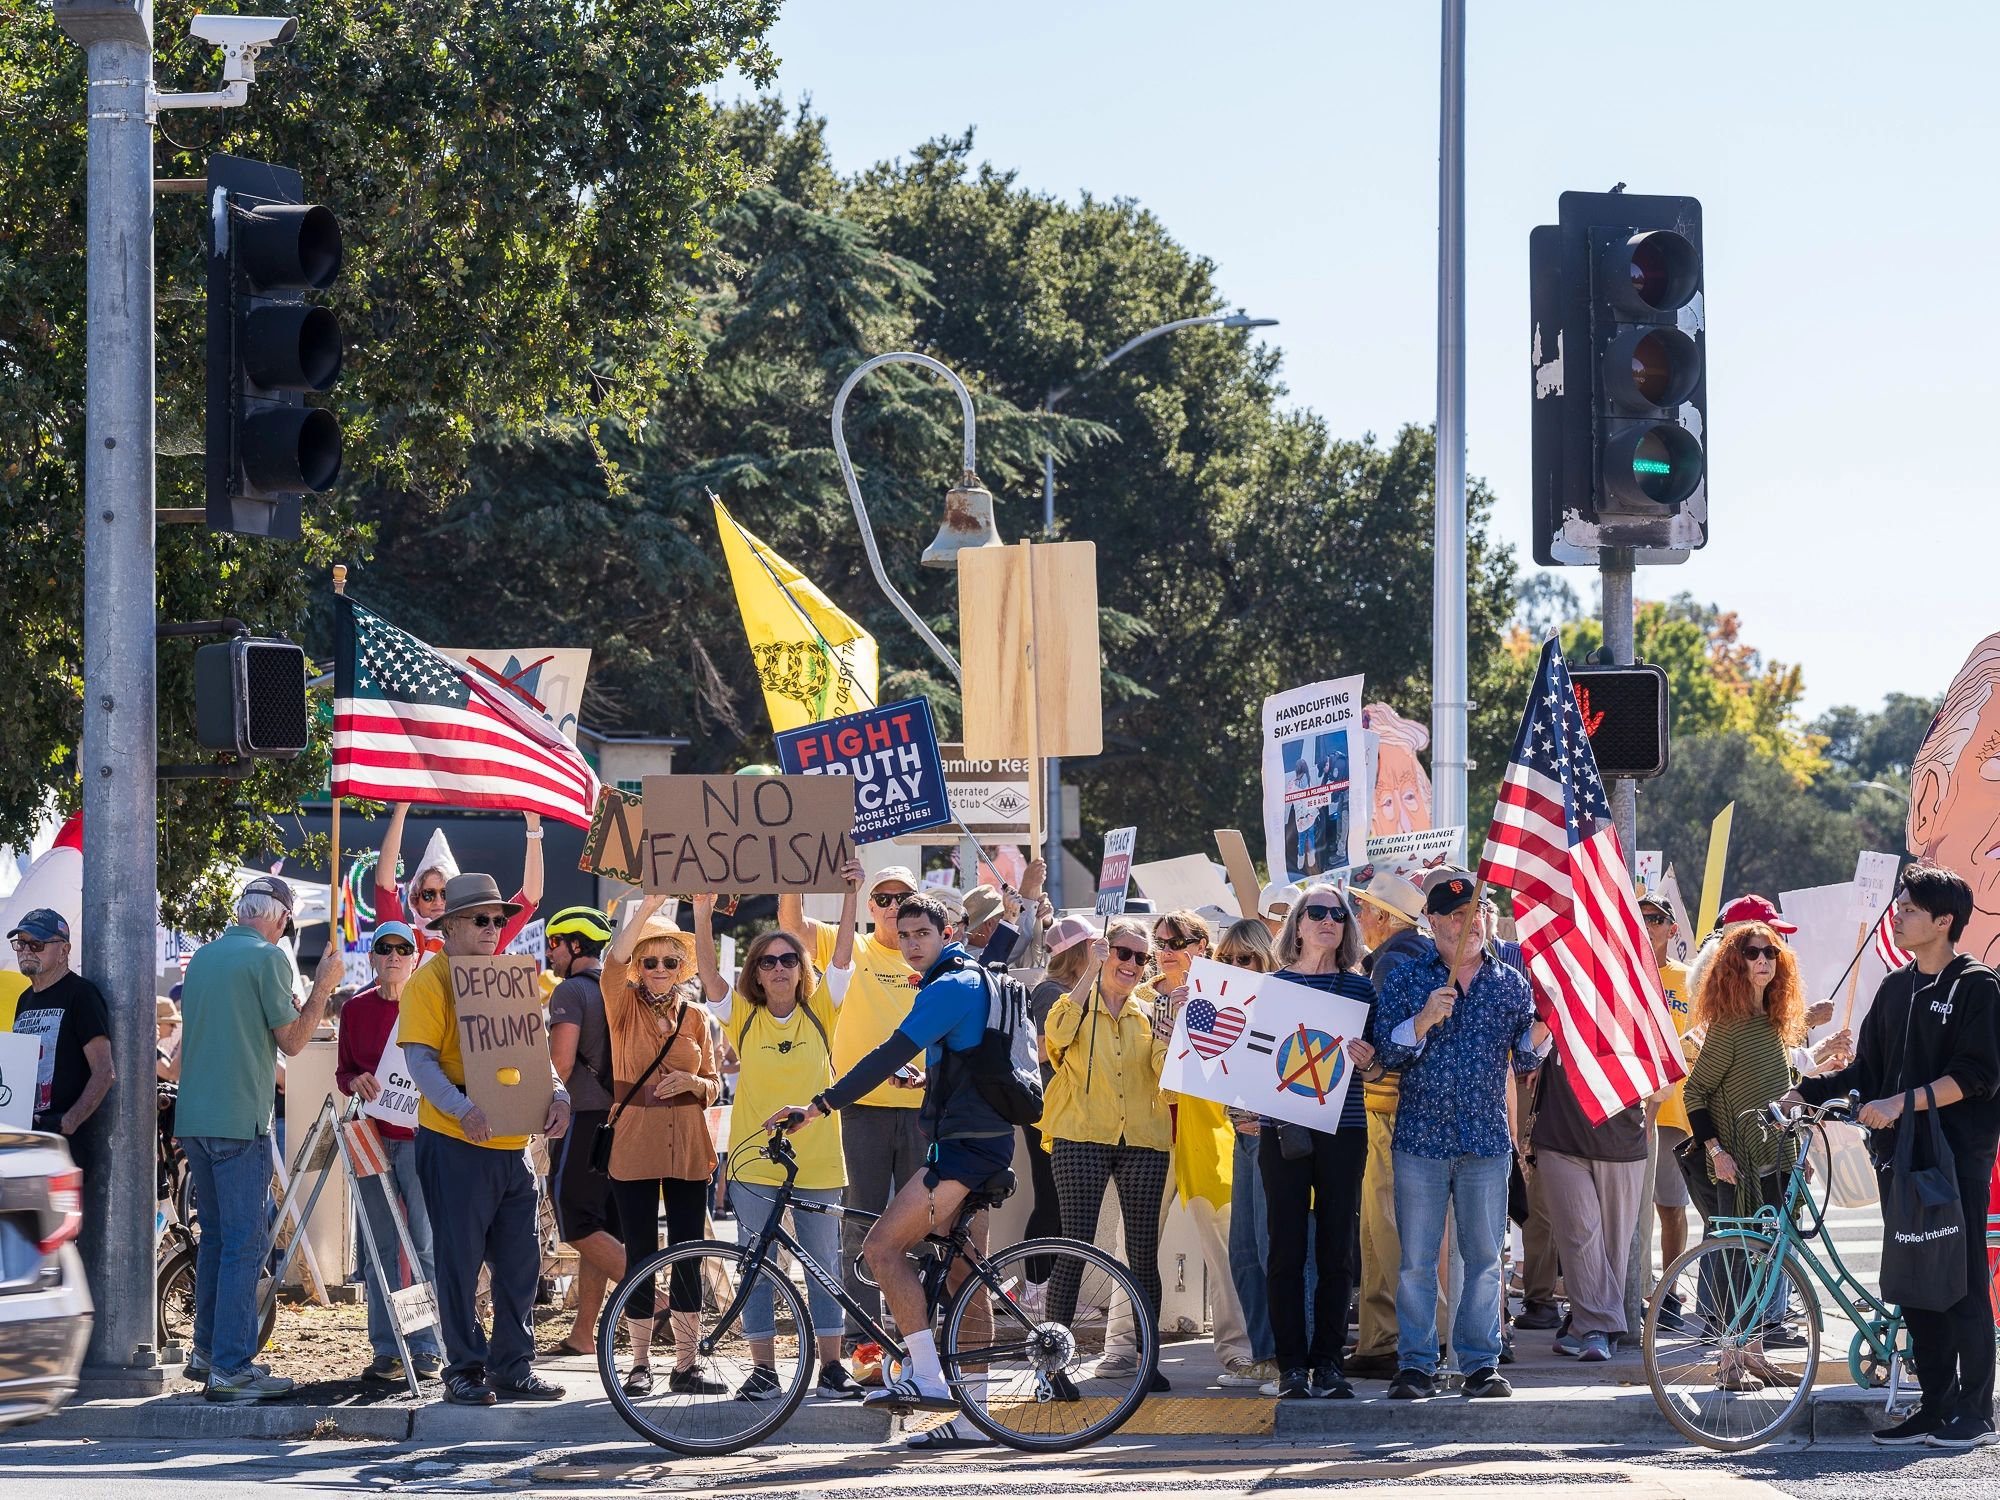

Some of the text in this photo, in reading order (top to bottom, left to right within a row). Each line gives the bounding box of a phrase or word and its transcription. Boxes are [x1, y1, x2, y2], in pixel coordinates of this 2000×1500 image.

[1276, 692, 1349, 721] HANDCUFFING
[1274, 708, 1353, 738] SIX-YEAR-OLDS.
[796, 713, 911, 768] FIGHT
[941, 758, 1030, 773] amino Rea
[702, 778, 793, 828] NO
[855, 771, 923, 812] CAY
[946, 786, 989, 796] ederated
[960, 799, 981, 809] Club
[998, 797, 1018, 809] AAA
[850, 808, 931, 835] MOCRACY DIES!
[855, 803, 910, 824] MORE LIES
[1366, 829, 1456, 847] THE ONLY ORANGE
[1423, 840, 1453, 850] WANT
[651, 831, 854, 887] FASCISM
[1102, 861, 1127, 881] REMOVE
[454, 965, 536, 999] DEPORT
[41, 1007, 64, 1017] FAMILY
[460, 1012, 541, 1052] TRUMP
[379, 1089, 420, 1115] KIN
[1924, 1225, 1959, 1240] Intuition
[790, 1246, 842, 1296] JAMIS
